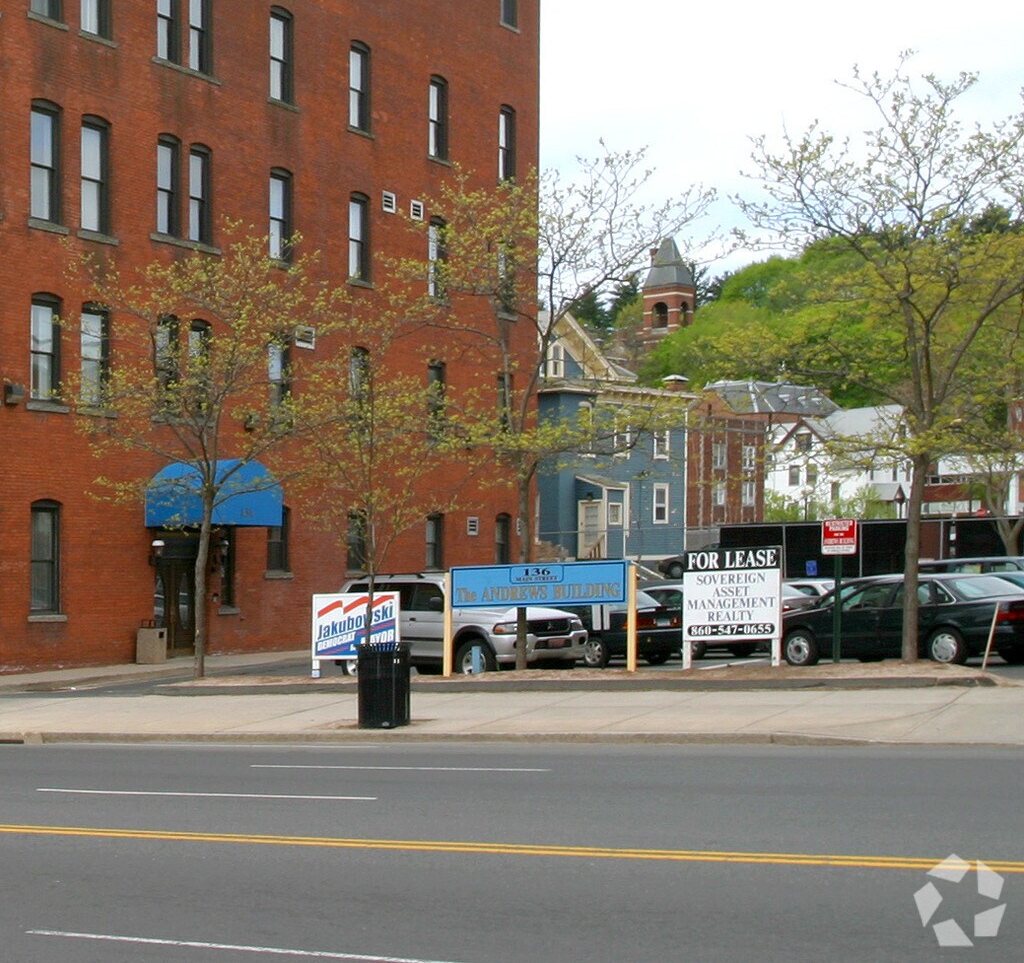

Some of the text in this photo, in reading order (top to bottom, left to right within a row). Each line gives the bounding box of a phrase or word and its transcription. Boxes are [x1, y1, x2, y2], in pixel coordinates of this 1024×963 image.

[687, 549, 777, 570] FOR LEASE
[523, 568, 550, 576] 136
[696, 572, 766, 586] SOVEREIGN
[457, 582, 621, 602] The ANDREWS BUILDING
[713, 586, 750, 598] ASSET
[687, 597, 775, 611] MANAGEMENT
[707, 610, 754, 622] REALTY
[690, 624, 771, 635] 860-547-0655
